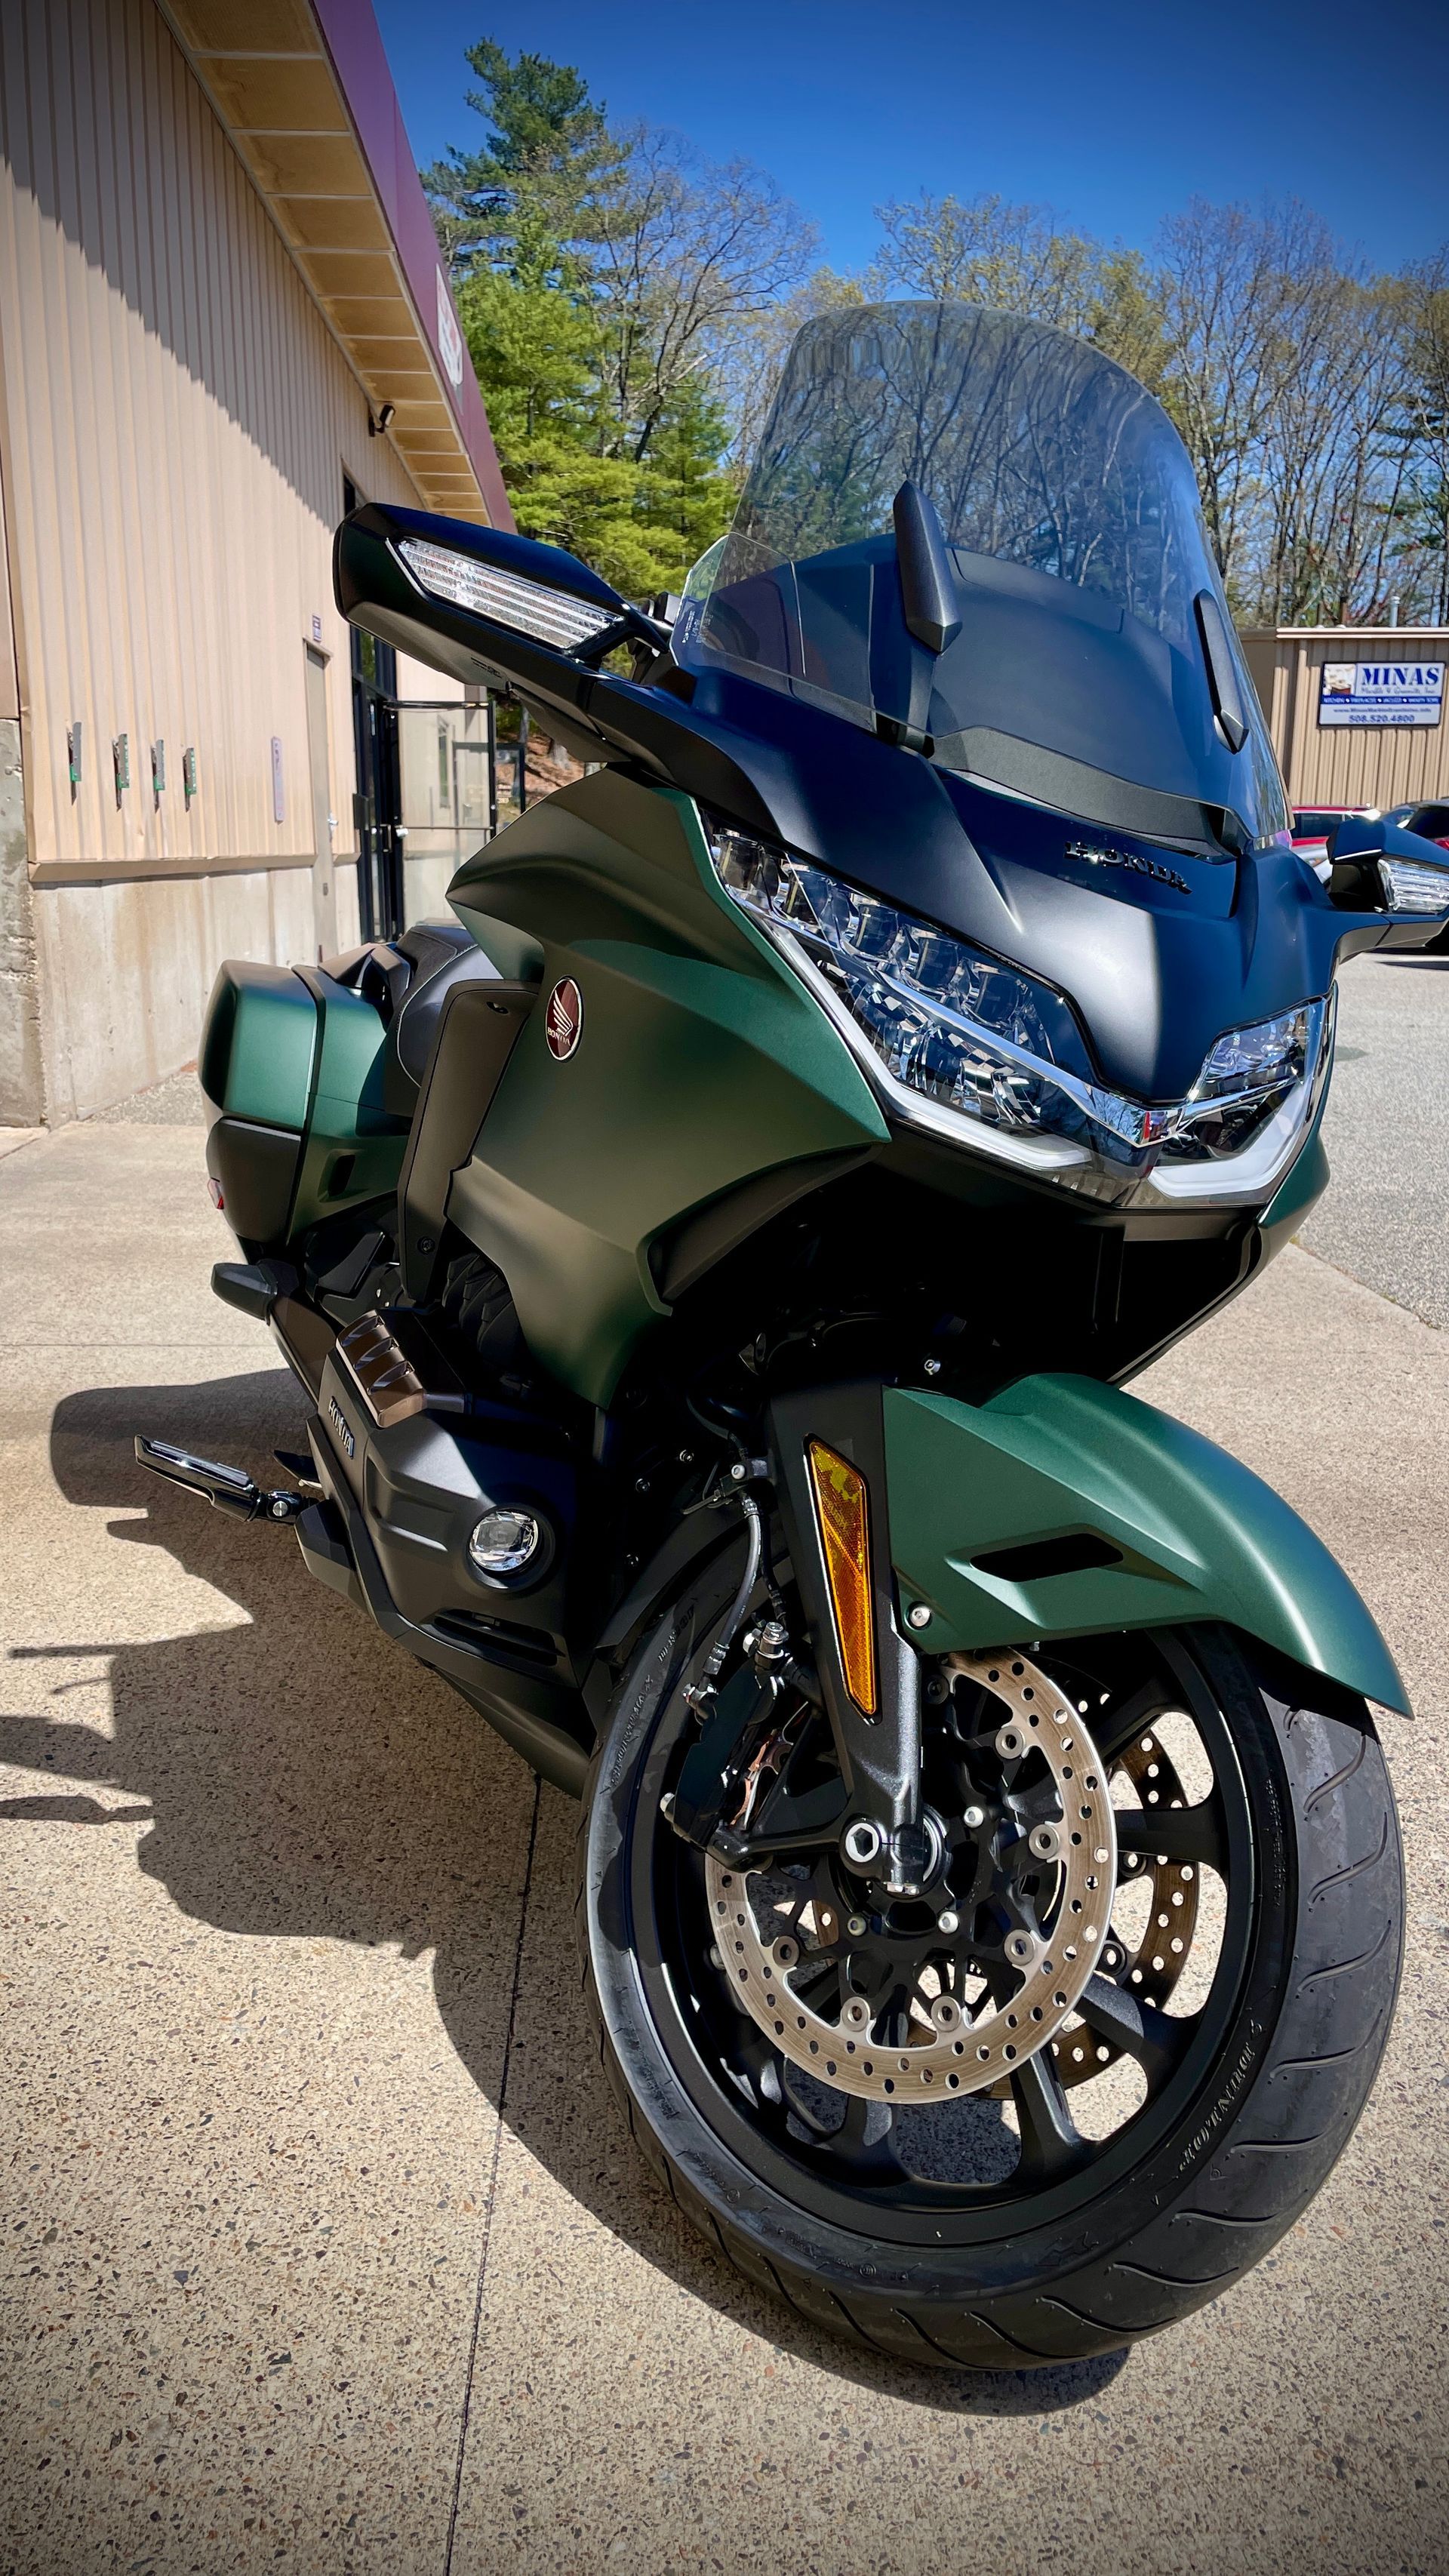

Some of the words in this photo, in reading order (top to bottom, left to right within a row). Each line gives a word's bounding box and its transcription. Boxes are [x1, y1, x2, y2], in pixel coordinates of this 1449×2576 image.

[1361, 667, 1440, 685] MINAS
[1063, 841, 1192, 895] HONDA
[547, 1026, 571, 1046] HONDA
[328, 1396, 355, 1460] HONDA
